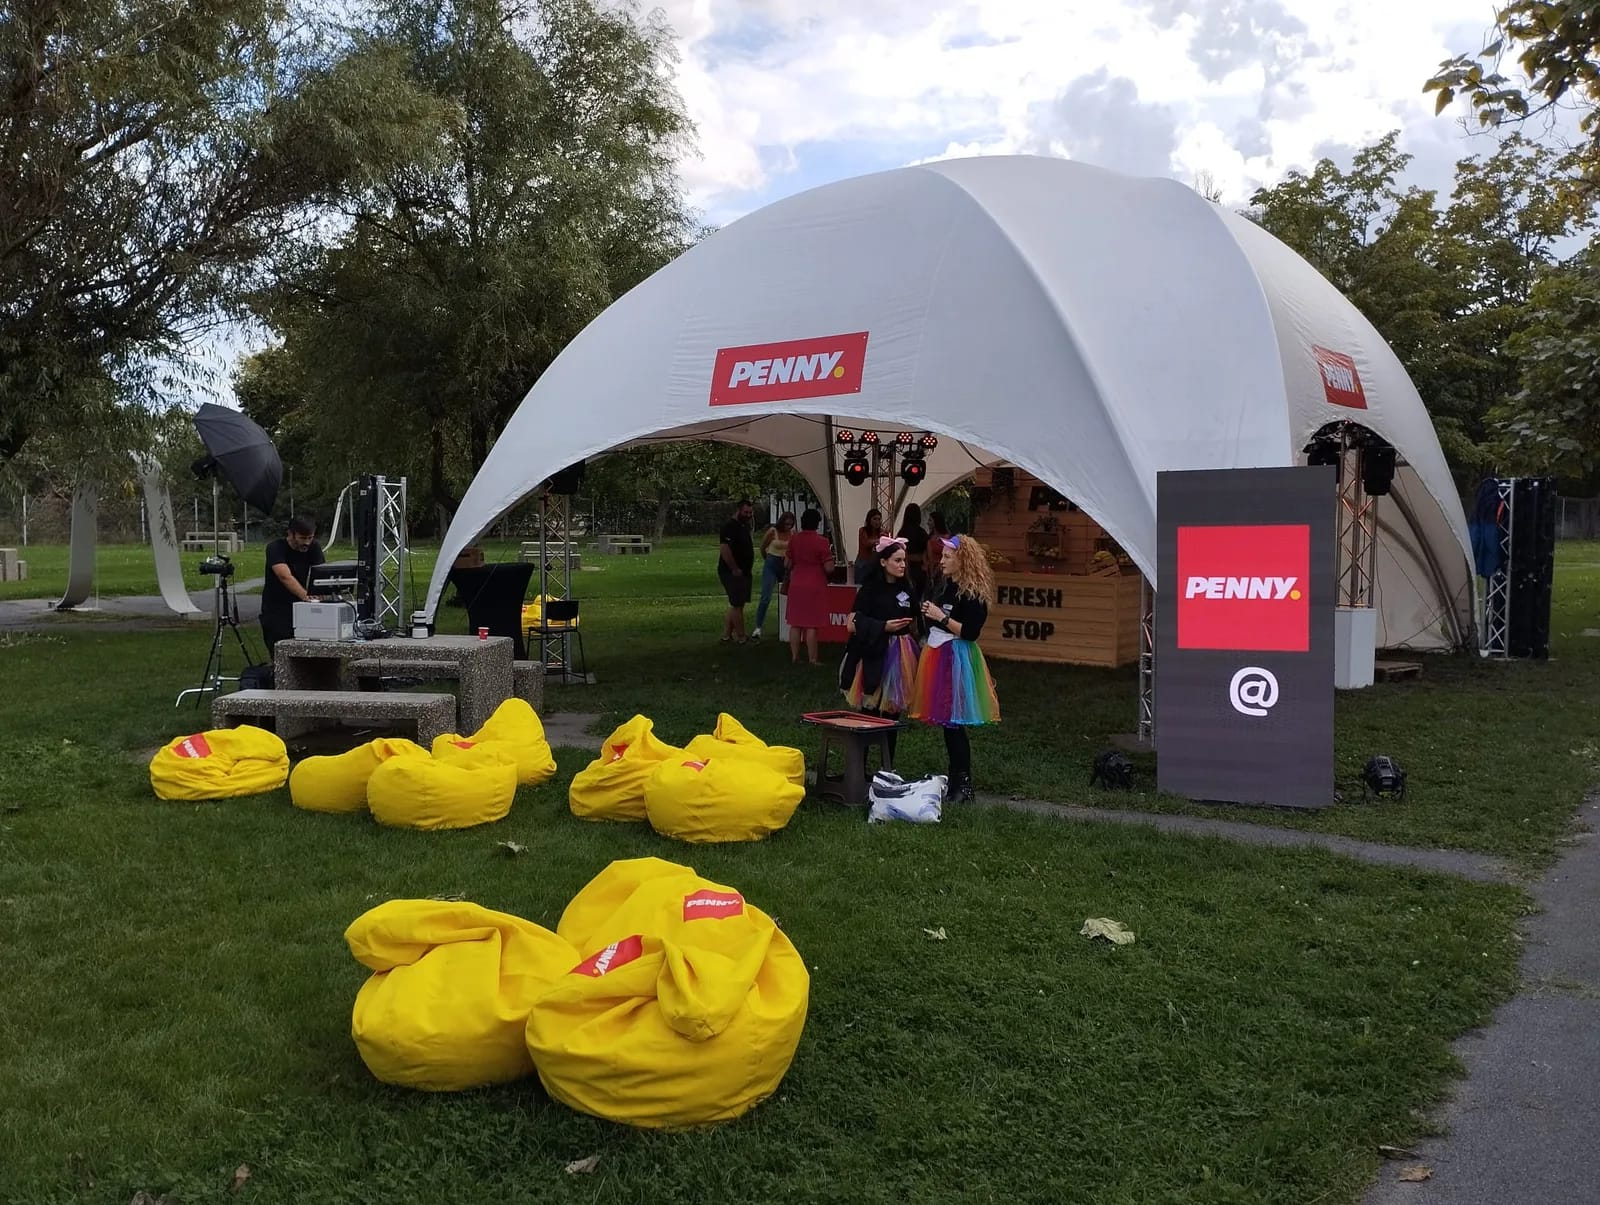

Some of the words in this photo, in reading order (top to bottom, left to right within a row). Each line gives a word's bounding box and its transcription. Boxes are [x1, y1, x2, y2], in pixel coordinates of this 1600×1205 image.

[728, 351, 845, 388] PENNY.
[997, 585, 1063, 608] FRESH
[1185, 576, 1301, 600] PENNY.
[1002, 619, 1055, 641] STOP
[1229, 666, 1279, 717] @
